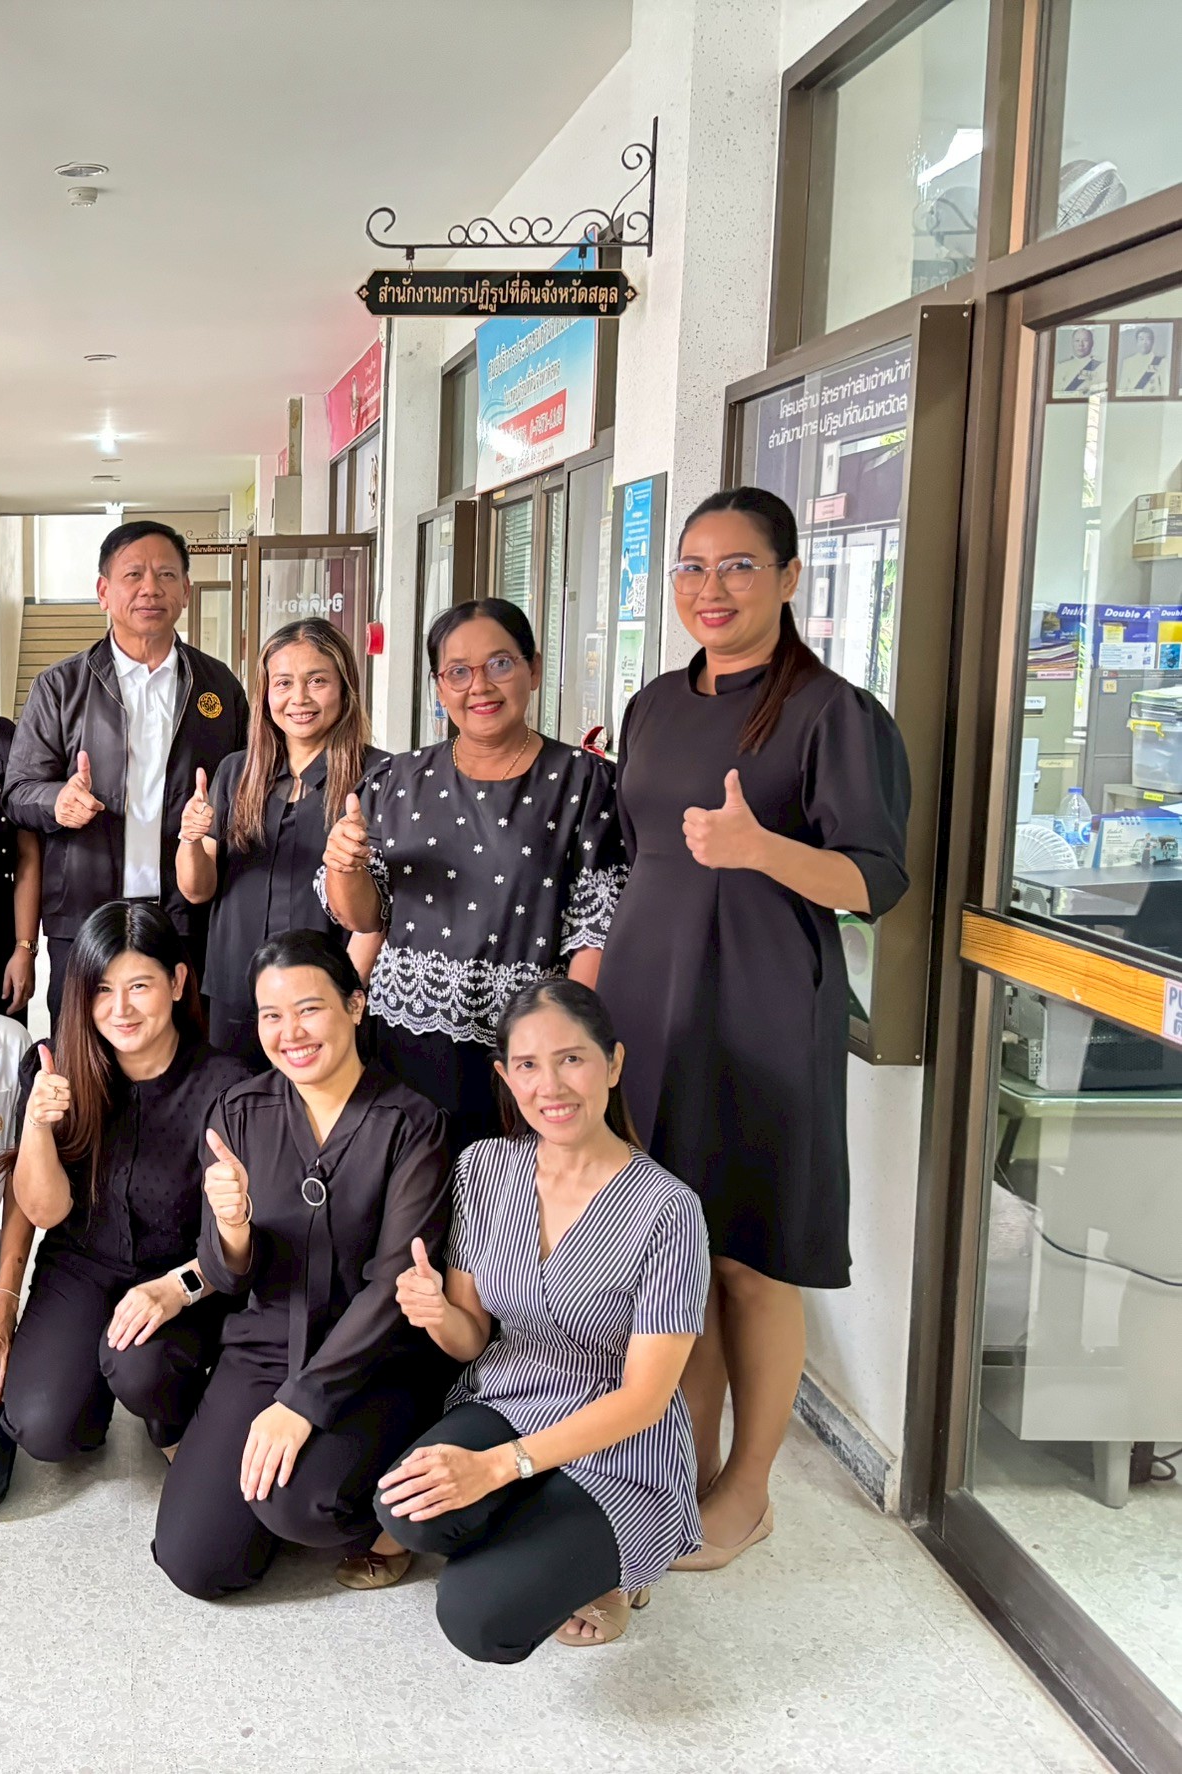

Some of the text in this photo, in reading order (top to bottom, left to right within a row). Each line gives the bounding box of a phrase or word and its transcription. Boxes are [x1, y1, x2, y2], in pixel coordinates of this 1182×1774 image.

[378, 271, 618, 312] สำนักงานการปฏิรูปที่ดินจังหวัดสตูล
[1104, 608, 1152, 619] Double A
